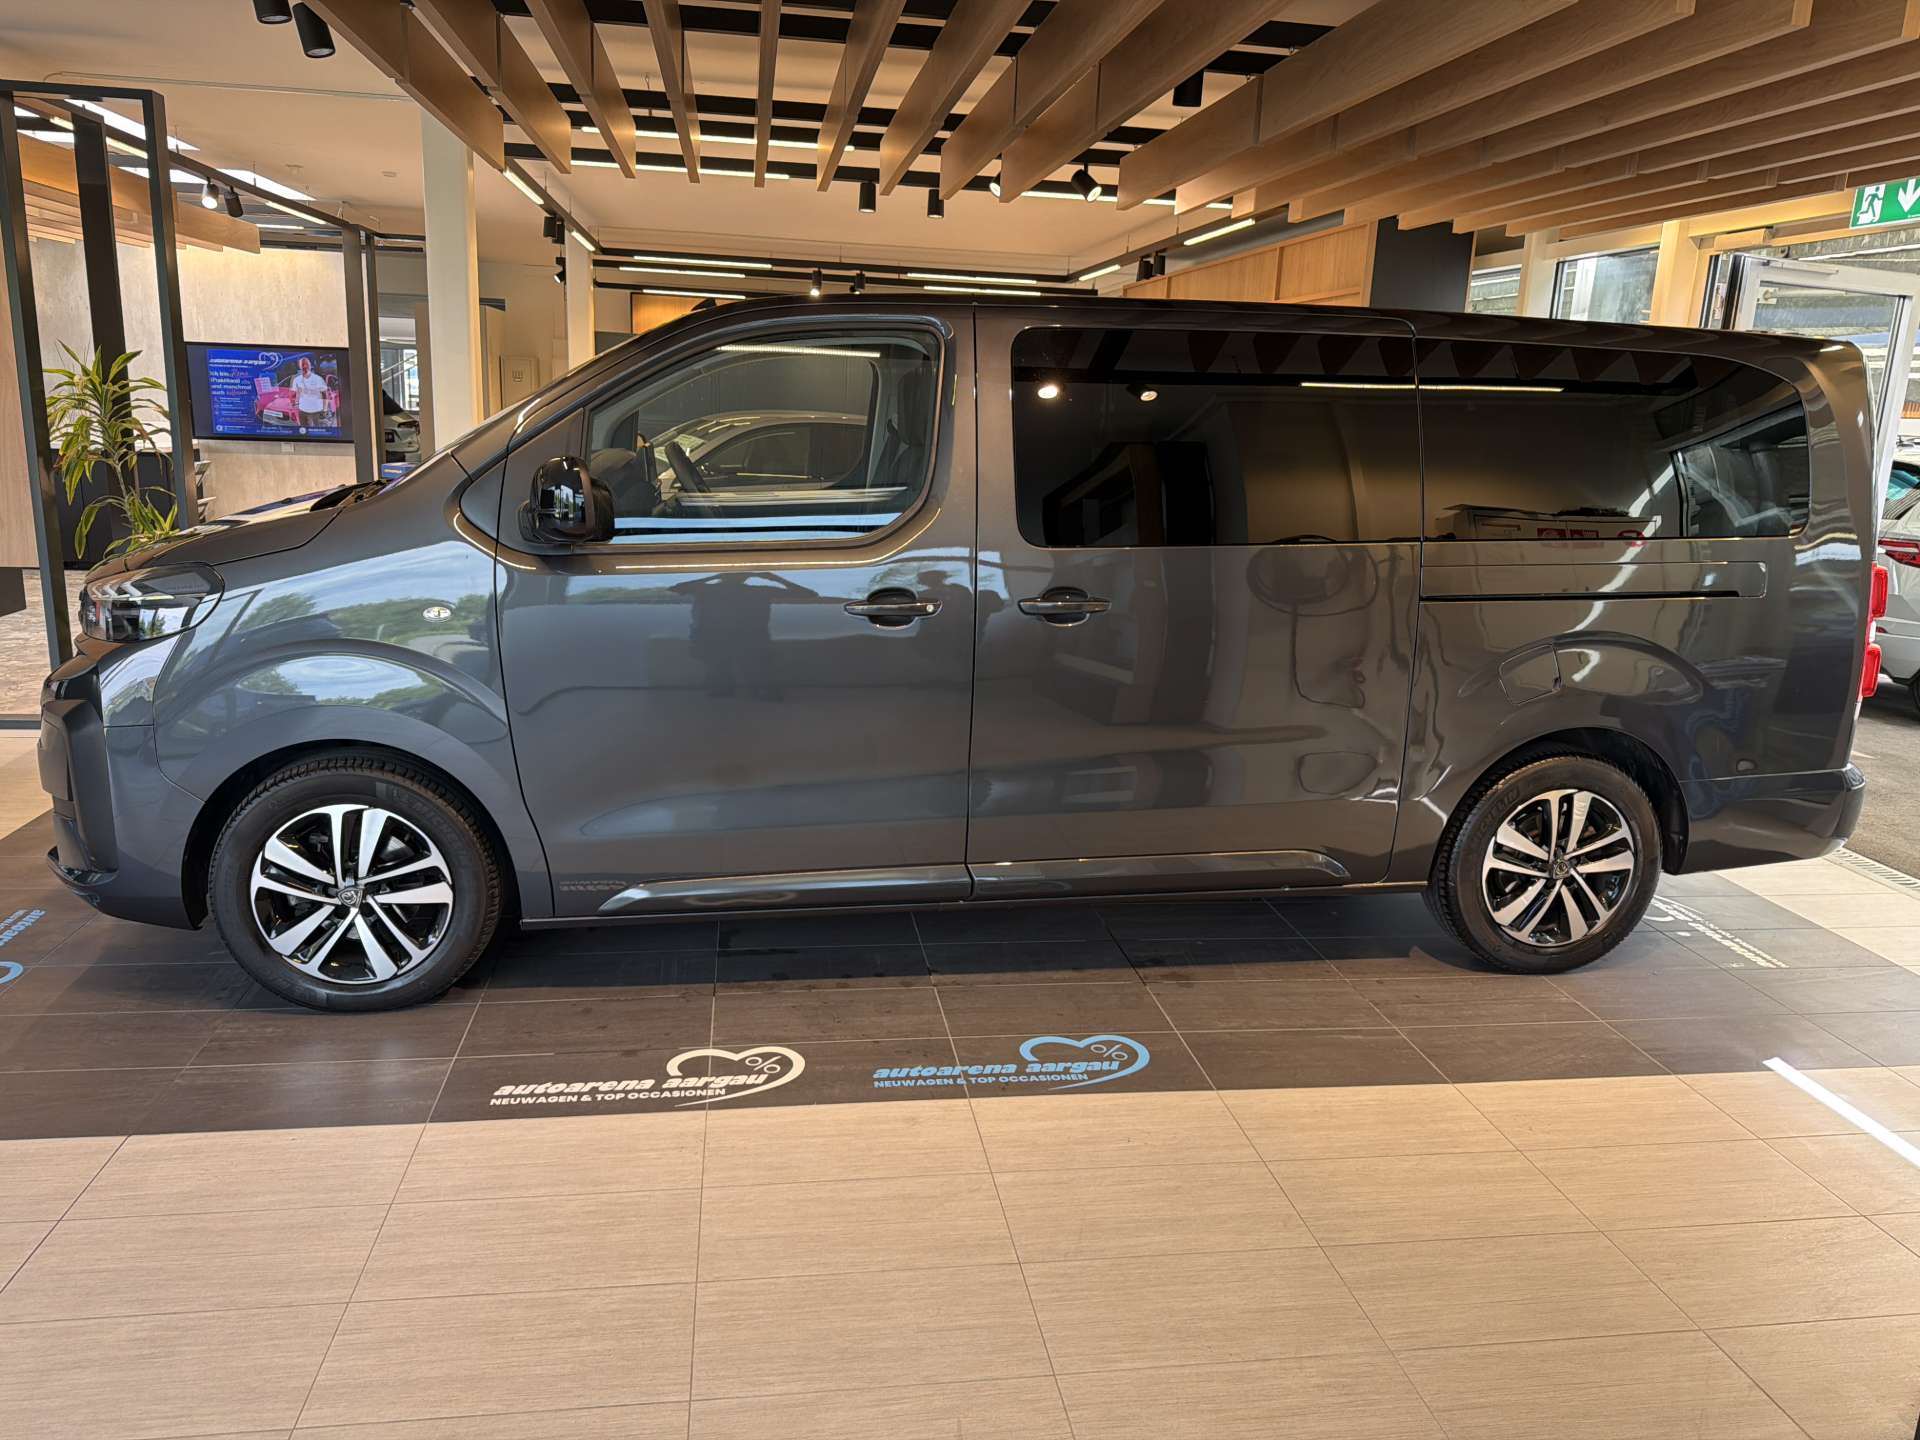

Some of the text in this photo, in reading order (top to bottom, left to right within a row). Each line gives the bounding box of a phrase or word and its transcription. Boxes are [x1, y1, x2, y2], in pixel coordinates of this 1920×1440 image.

[873, 1060, 1121, 1079] autoarena aargau
[493, 1073, 769, 1096] autoarena aargau
[873, 1078, 954, 1089] NEUWAGEN
[968, 1076, 996, 1085] TOP
[998, 1073, 1089, 1084] OCCASIONEN
[489, 1094, 579, 1106] NEUWAGEN
[595, 1093, 625, 1101] TOP
[627, 1088, 726, 1099] OCCASIONEN
